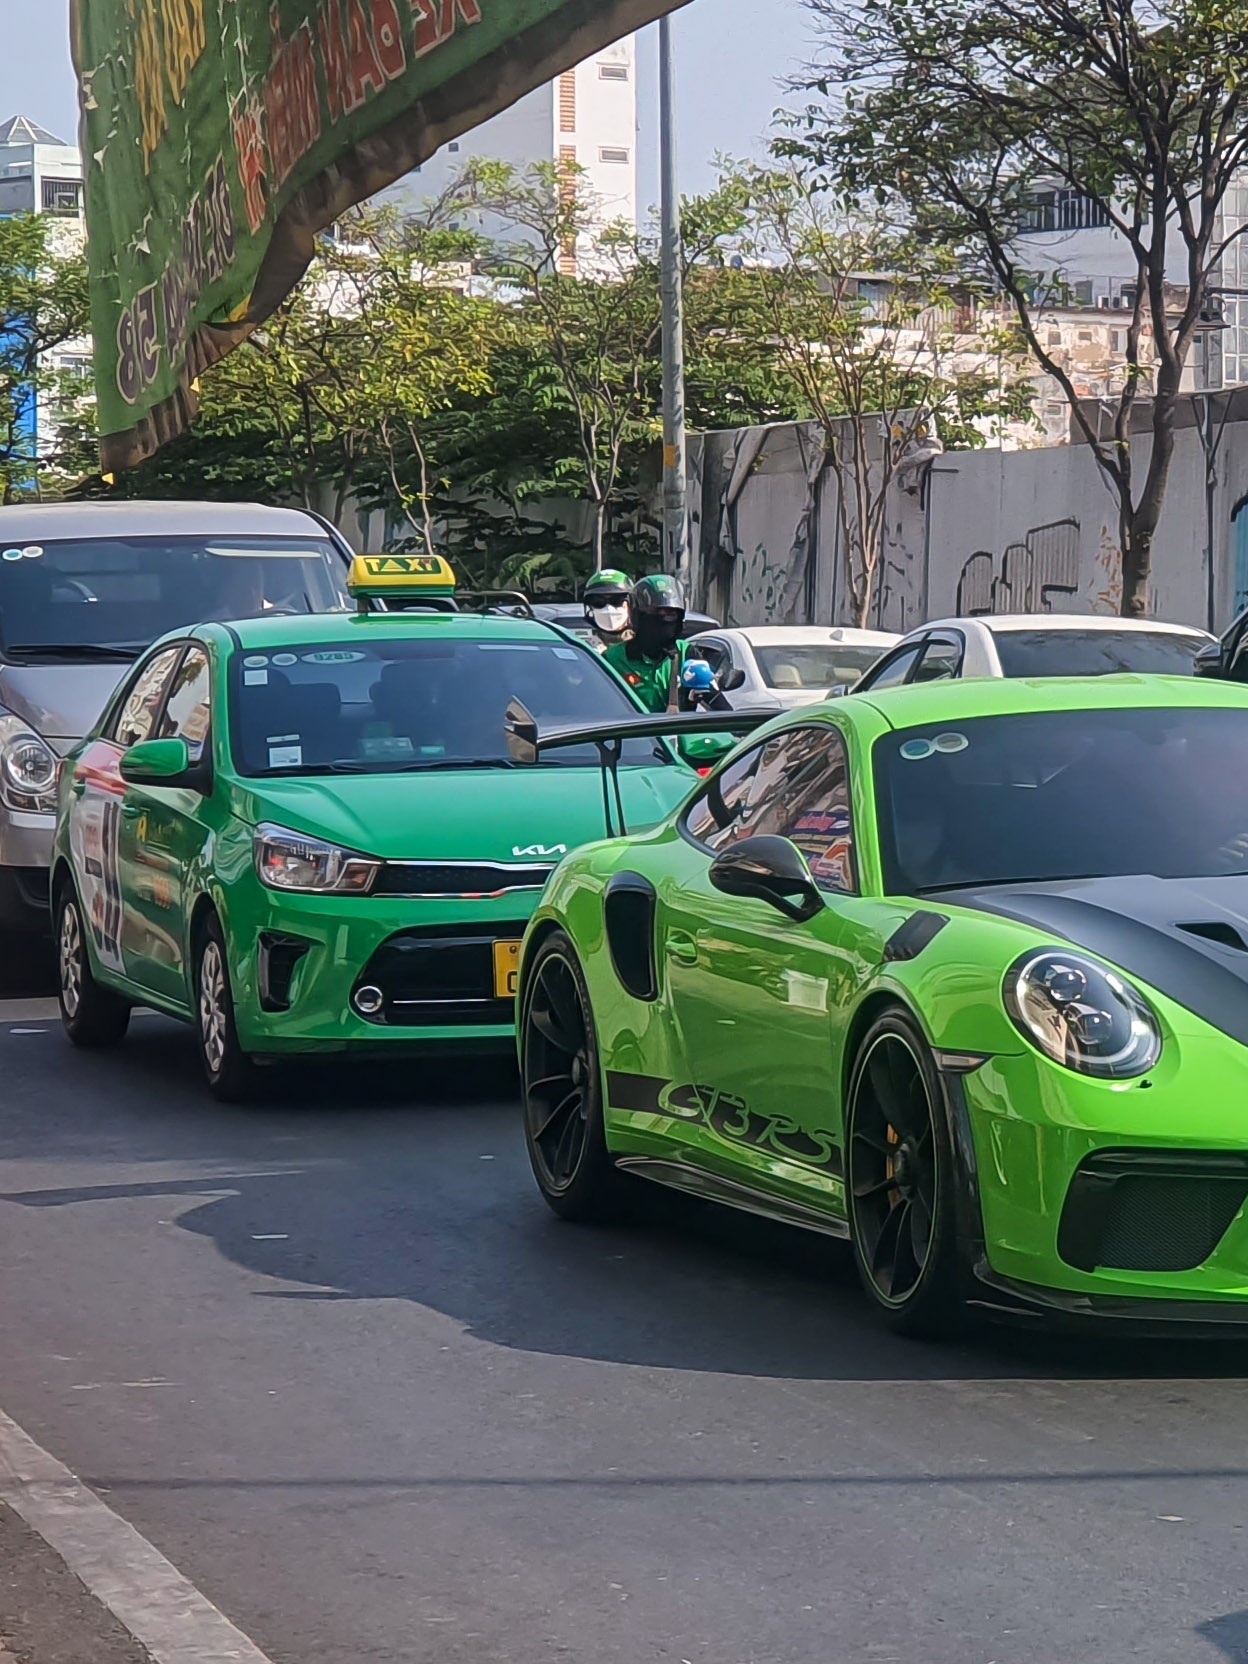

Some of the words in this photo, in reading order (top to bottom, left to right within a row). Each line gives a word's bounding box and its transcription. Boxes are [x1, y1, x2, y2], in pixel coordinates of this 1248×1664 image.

[366, 558, 433, 572] TAXI
[512, 844, 566, 856] KIA
[658, 1081, 750, 1136] GT3
[755, 1113, 844, 1164] RS
